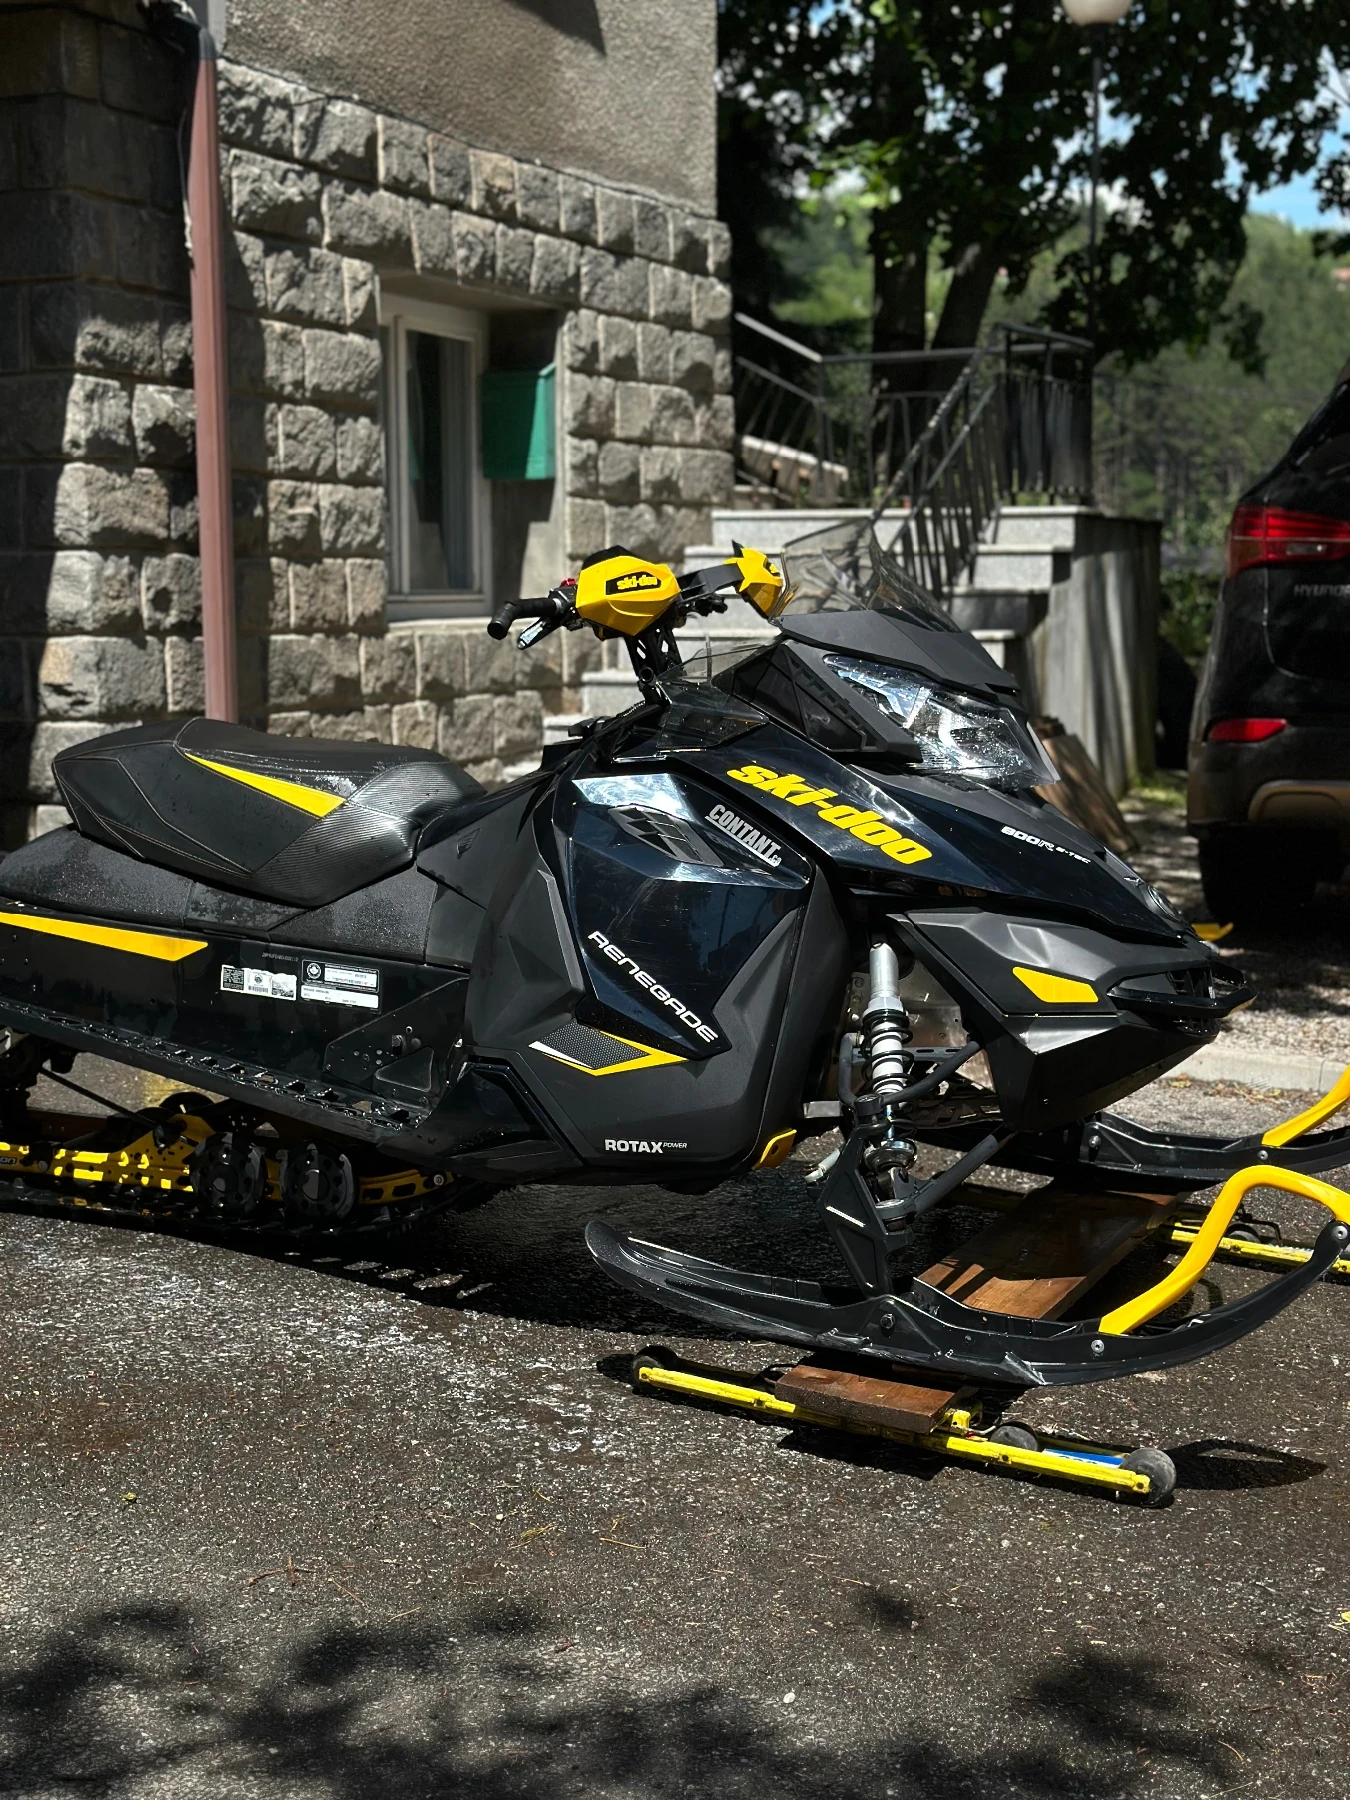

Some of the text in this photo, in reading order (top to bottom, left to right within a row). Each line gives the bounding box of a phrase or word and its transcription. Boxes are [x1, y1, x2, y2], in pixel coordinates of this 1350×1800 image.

[726, 765, 933, 865] ski-doo
[588, 931, 719, 1043] RENEGADE
[604, 1139, 663, 1154] ROTAX
